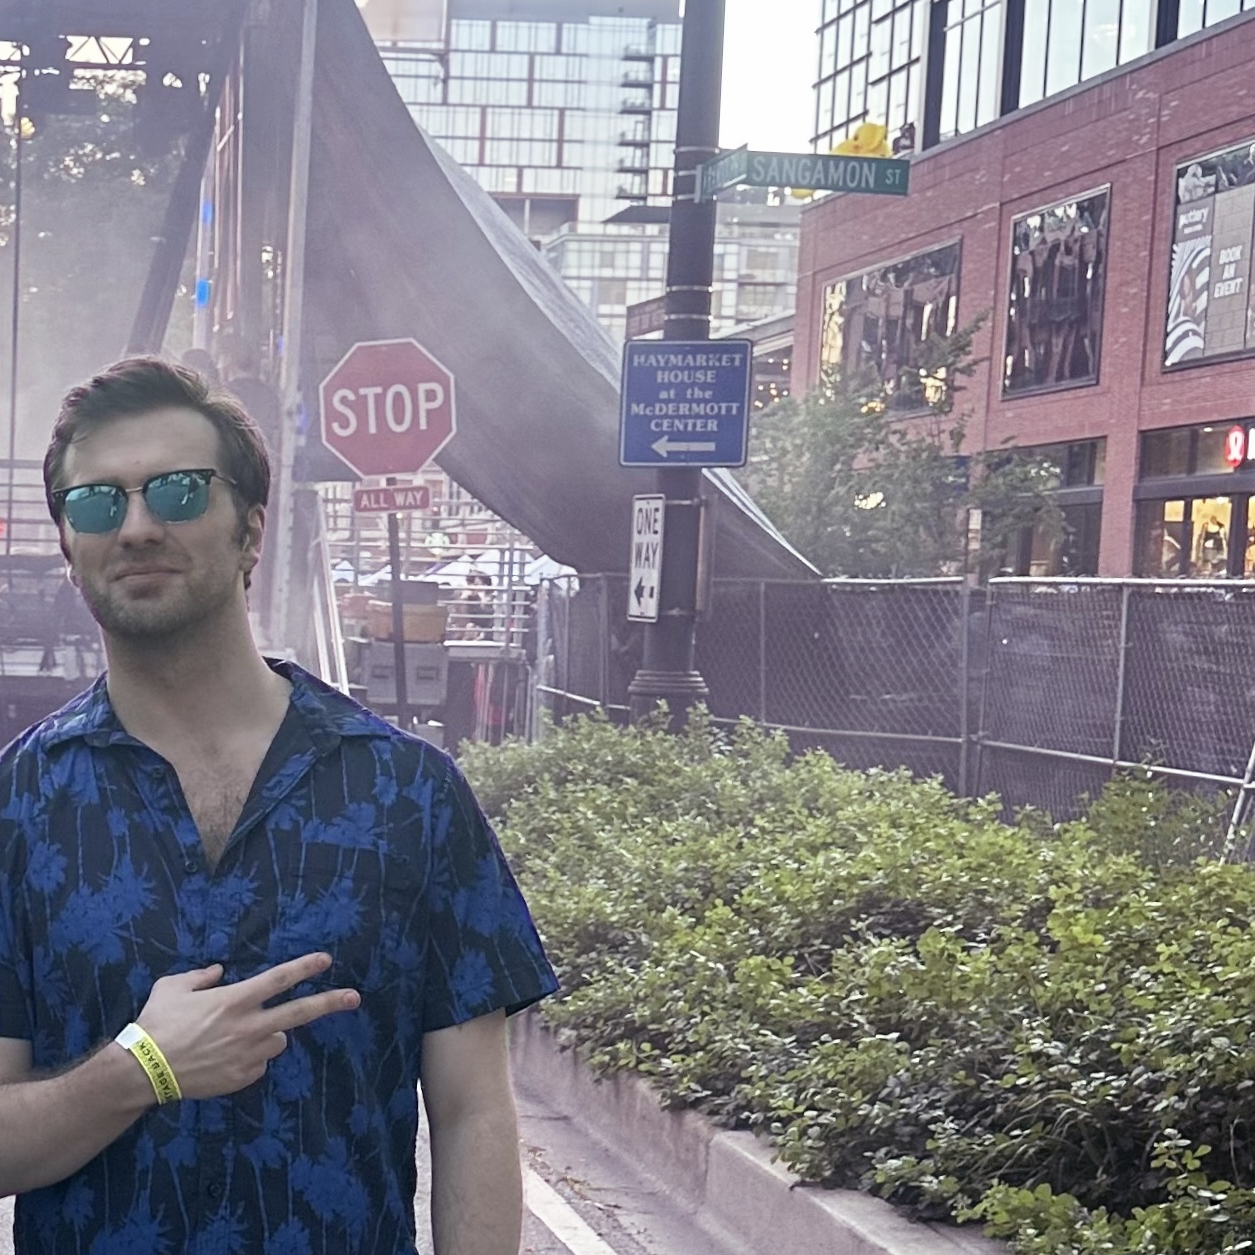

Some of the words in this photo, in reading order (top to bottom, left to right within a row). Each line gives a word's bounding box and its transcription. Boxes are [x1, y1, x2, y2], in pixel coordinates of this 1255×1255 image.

[752, 156, 876, 188] SANGAMON
[885, 169, 902, 185] ST
[1219, 245, 1243, 265] BOOK
[1214, 277, 1243, 298] EVENT
[633, 354, 743, 367] HAYMARKET
[656, 370, 716, 383] HOUSE
[659, 388, 675, 399] at
[686, 387, 713, 399] the
[331, 382, 444, 437] STOP
[630, 402, 740, 416] McDERMOTT
[650, 419, 718, 432] CENTER
[360, 494, 388, 509] ALL
[394, 491, 424, 507] WAY
[636, 507, 660, 535] ONE
[634, 542, 659, 569] WAY
[140, 1042, 160, 1070] BACK
